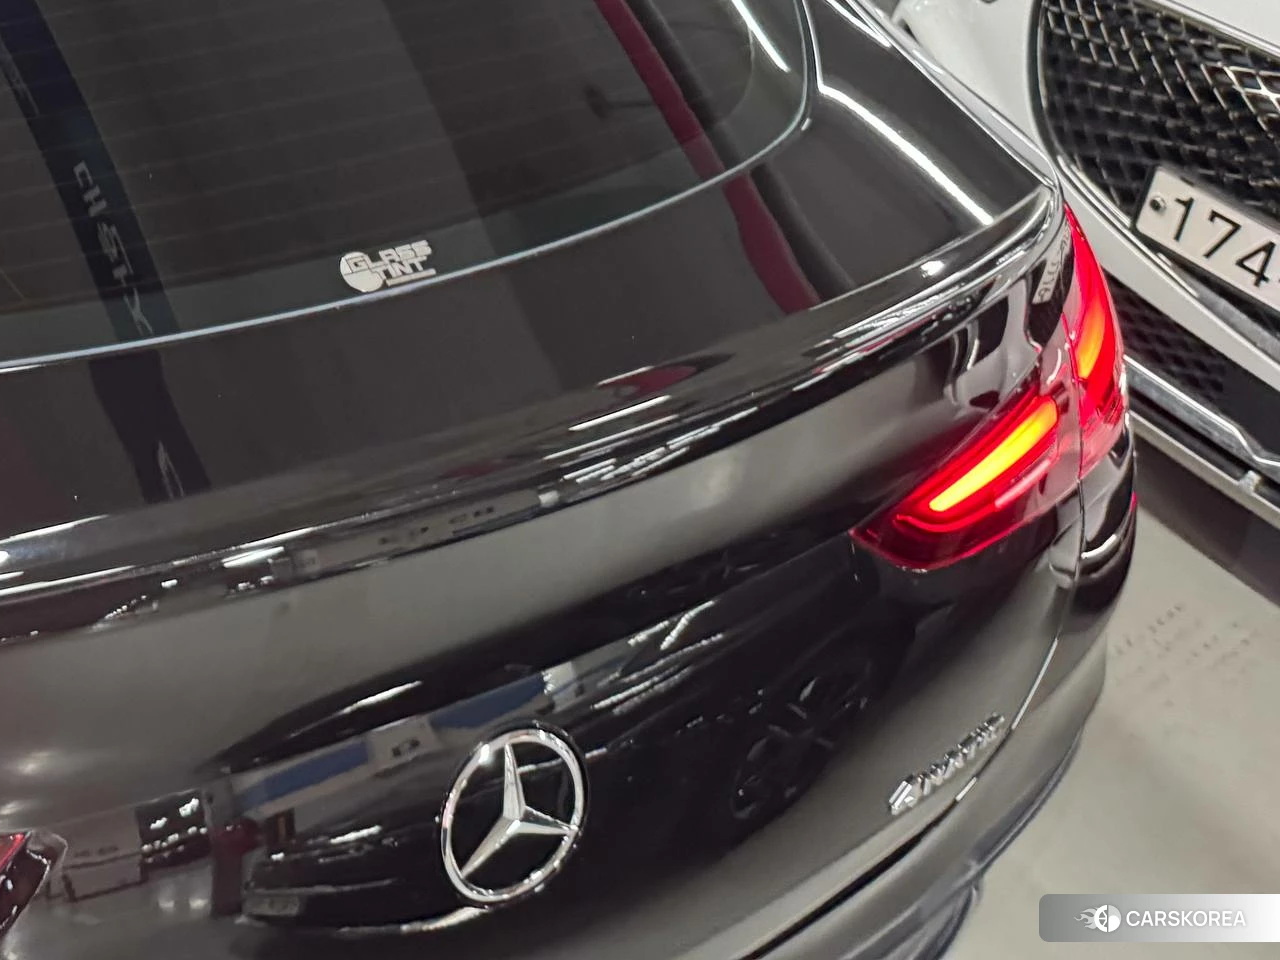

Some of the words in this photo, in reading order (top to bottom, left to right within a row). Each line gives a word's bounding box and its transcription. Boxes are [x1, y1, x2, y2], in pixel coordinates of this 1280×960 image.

[345, 240, 432, 276] GLASS
[1174, 196, 1280, 287] 174
[371, 256, 428, 282] TINT
